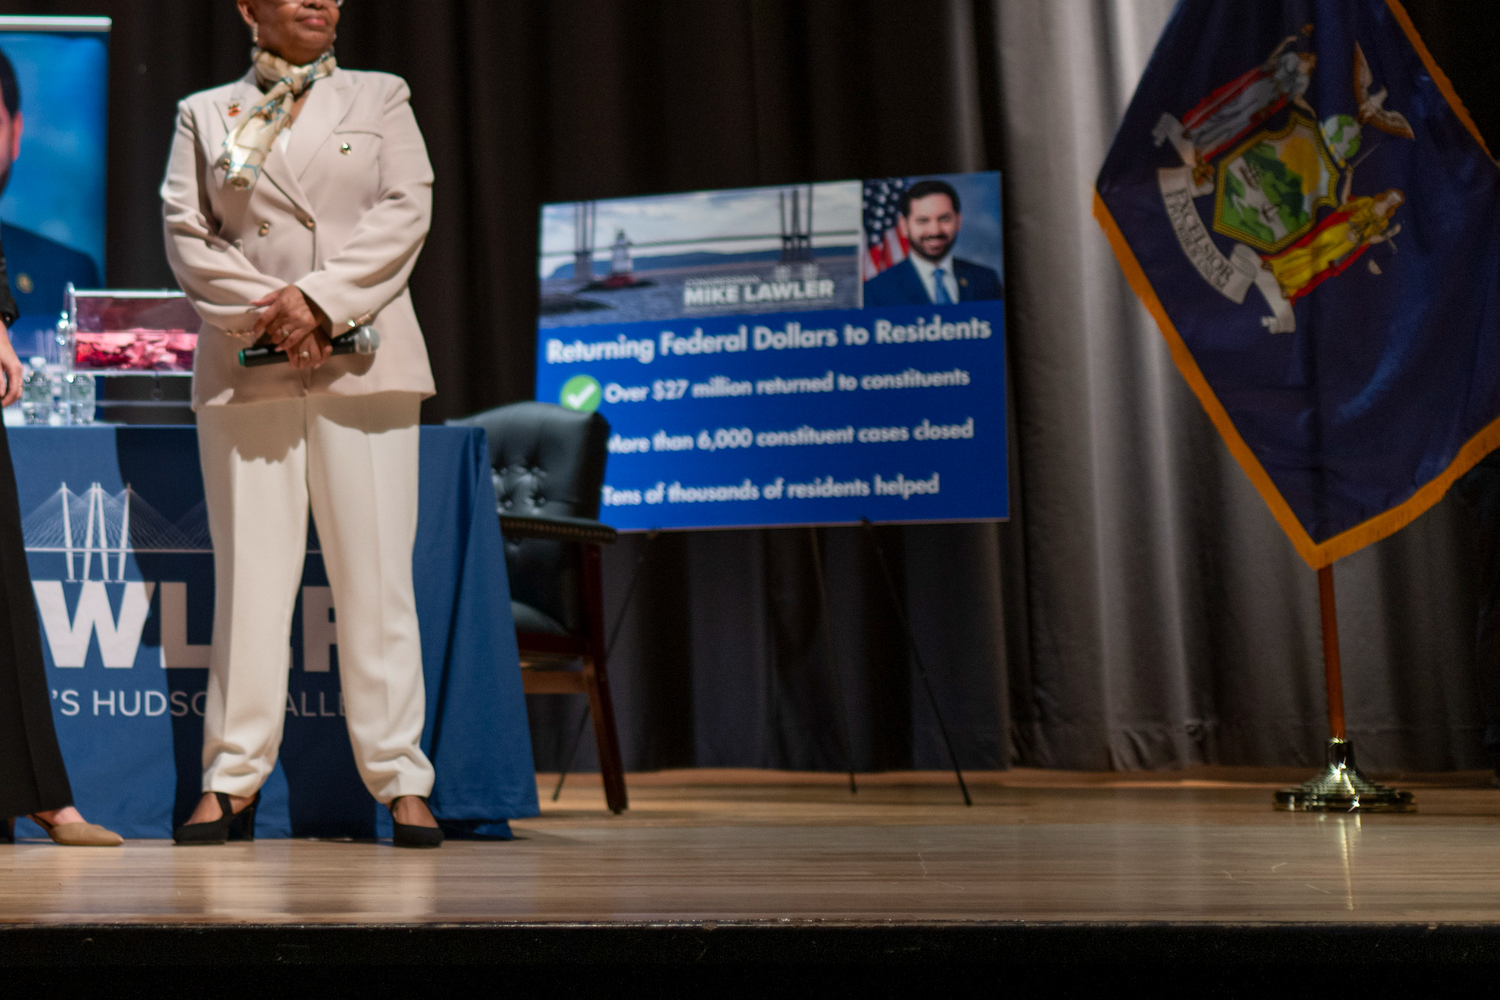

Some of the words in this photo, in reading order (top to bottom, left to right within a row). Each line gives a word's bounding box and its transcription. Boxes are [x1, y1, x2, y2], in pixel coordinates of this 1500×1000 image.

[683, 285, 740, 307] MIKE
[744, 279, 835, 303] LAWLER
[546, 333, 656, 365] Returning
[660, 324, 748, 357] Federal
[753, 321, 839, 351] Dollars
[843, 323, 870, 347] to
[875, 314, 993, 345] Residents
[604, 382, 650, 404] Over
[652, 378, 690, 401] $27
[692, 375, 753, 399] million
[756, 370, 835, 396] returned
[837, 373, 859, 392] to
[860, 367, 971, 391] constituents
[652, 429, 695, 453] than
[696, 426, 754, 453] 6,000
[755, 424, 855, 447] constituent
[857, 426, 910, 444] cases
[912, 416, 975, 441] closed
[602, 484, 643, 507] Tens
[644, 480, 667, 505] of
[667, 477, 761, 504] thousands
[762, 476, 786, 501] of
[787, 475, 871, 500] residents
[873, 471, 941, 501] helped
[92, 689, 208, 717] HUDS
